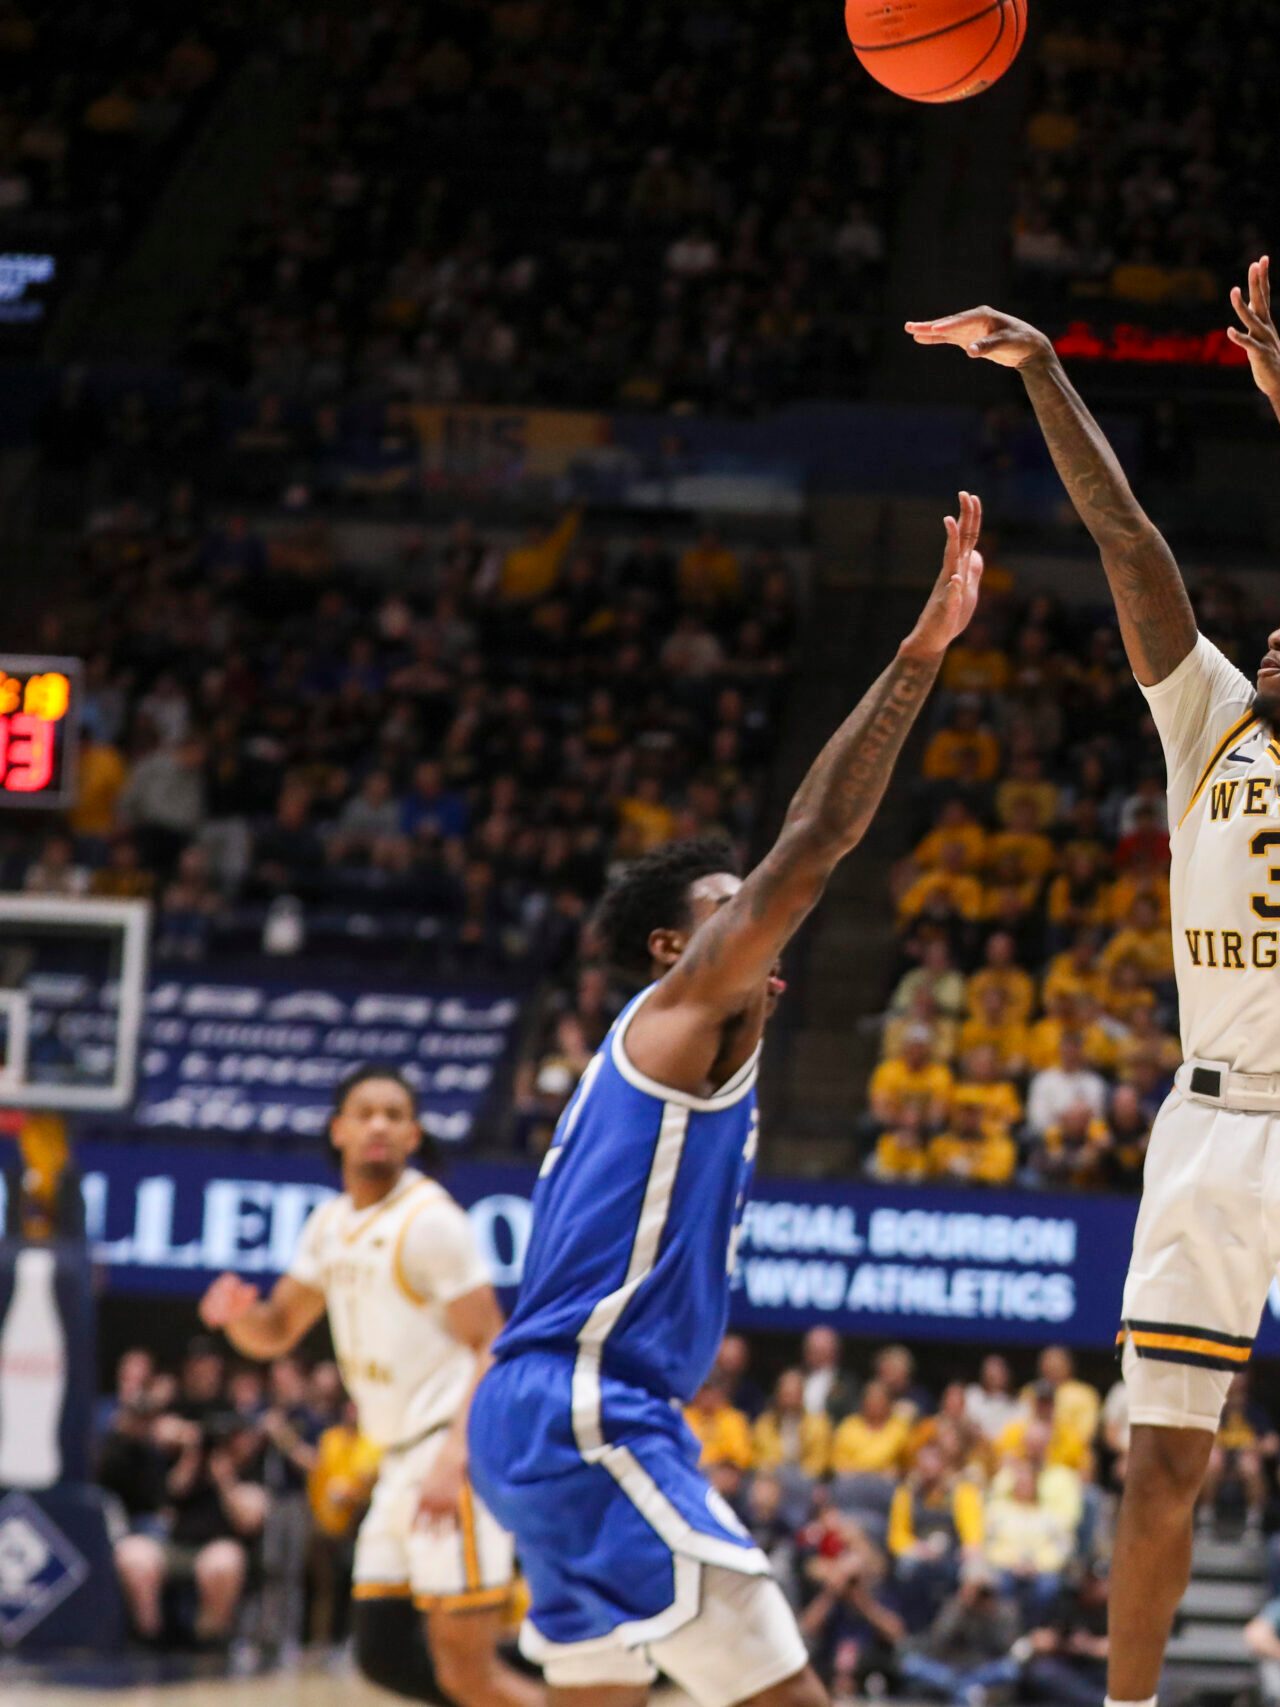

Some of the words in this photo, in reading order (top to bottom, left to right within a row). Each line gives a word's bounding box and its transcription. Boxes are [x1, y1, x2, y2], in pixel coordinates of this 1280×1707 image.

[868, 1206, 1078, 1267] BOURBON
[744, 1256, 849, 1311] WVU
[847, 1262, 1078, 1324] ATHLETICS
